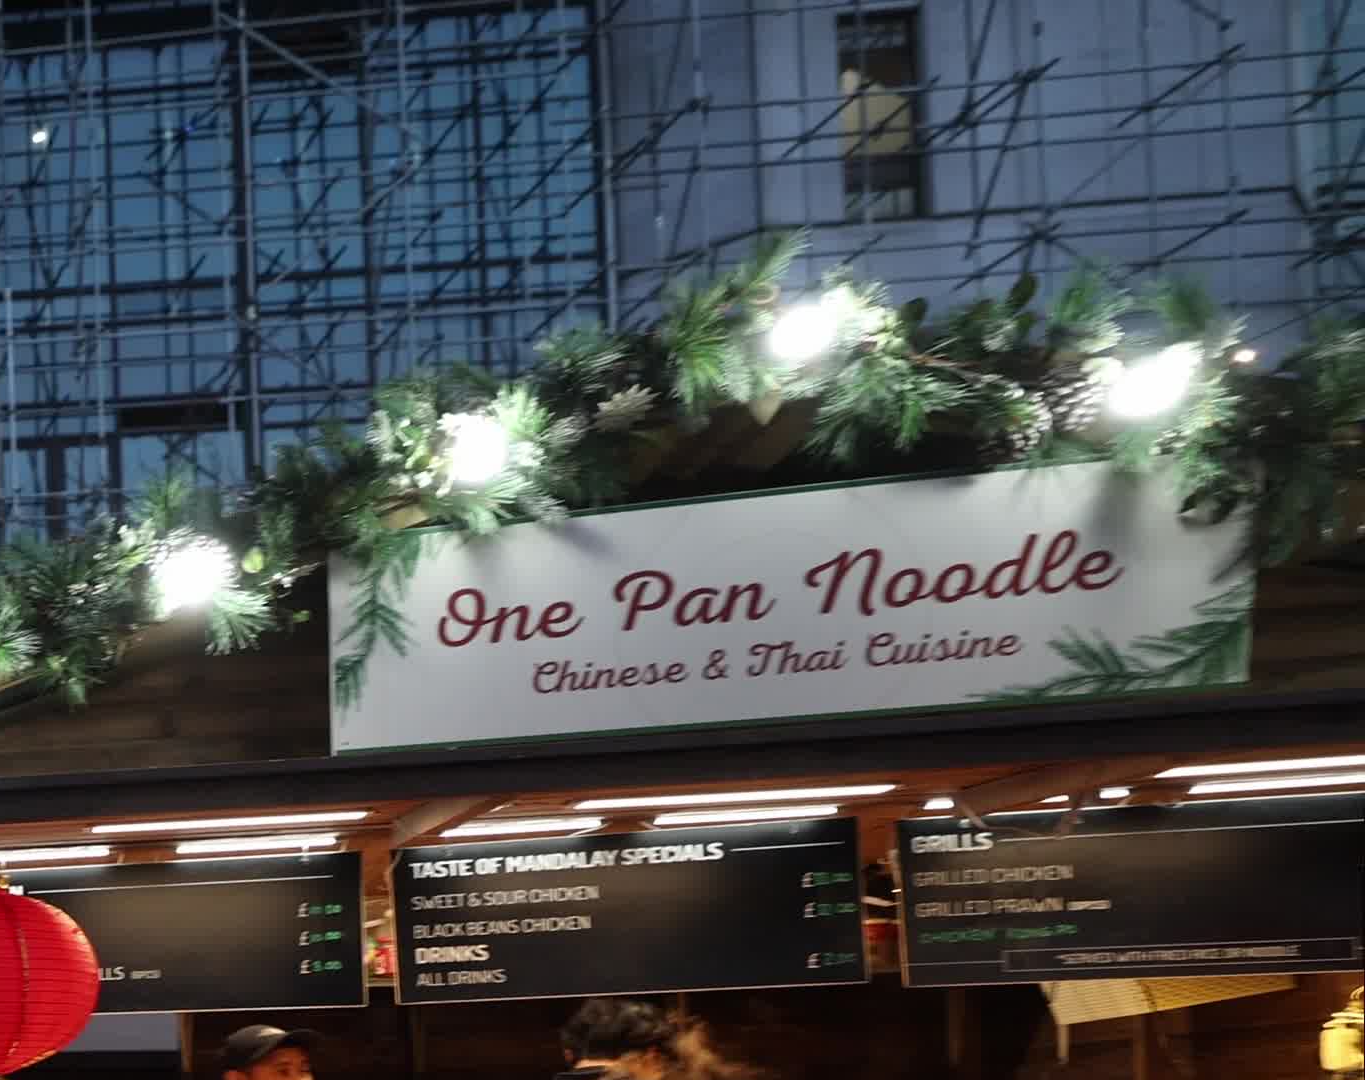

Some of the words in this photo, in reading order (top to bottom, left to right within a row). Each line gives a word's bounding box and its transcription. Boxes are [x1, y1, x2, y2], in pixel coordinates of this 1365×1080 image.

[438, 588, 583, 648] One
[616, 570, 775, 632] Pan
[805, 530, 1124, 617] Noodle
[533, 653, 687, 695] Chinese
[703, 648, 730, 680] &
[747, 638, 846, 678] Thai
[868, 629, 1021, 668] Cuisine
[911, 832, 993, 853] GRILLS
[410, 858, 473, 879] TASTE
[475, 856, 503, 875] OF
[507, 850, 617, 873] MANDALAY
[622, 843, 724, 865] SPECIALS
[913, 869, 990, 886] GRILLED
[411, 892, 465, 911] SWEET
[916, 901, 991, 918] GRILLED
[413, 922, 466, 939] BLACK
[415, 945, 490, 963] DRINKS
[416, 972, 445, 986] ALL
[448, 968, 507, 985] DRINKS
